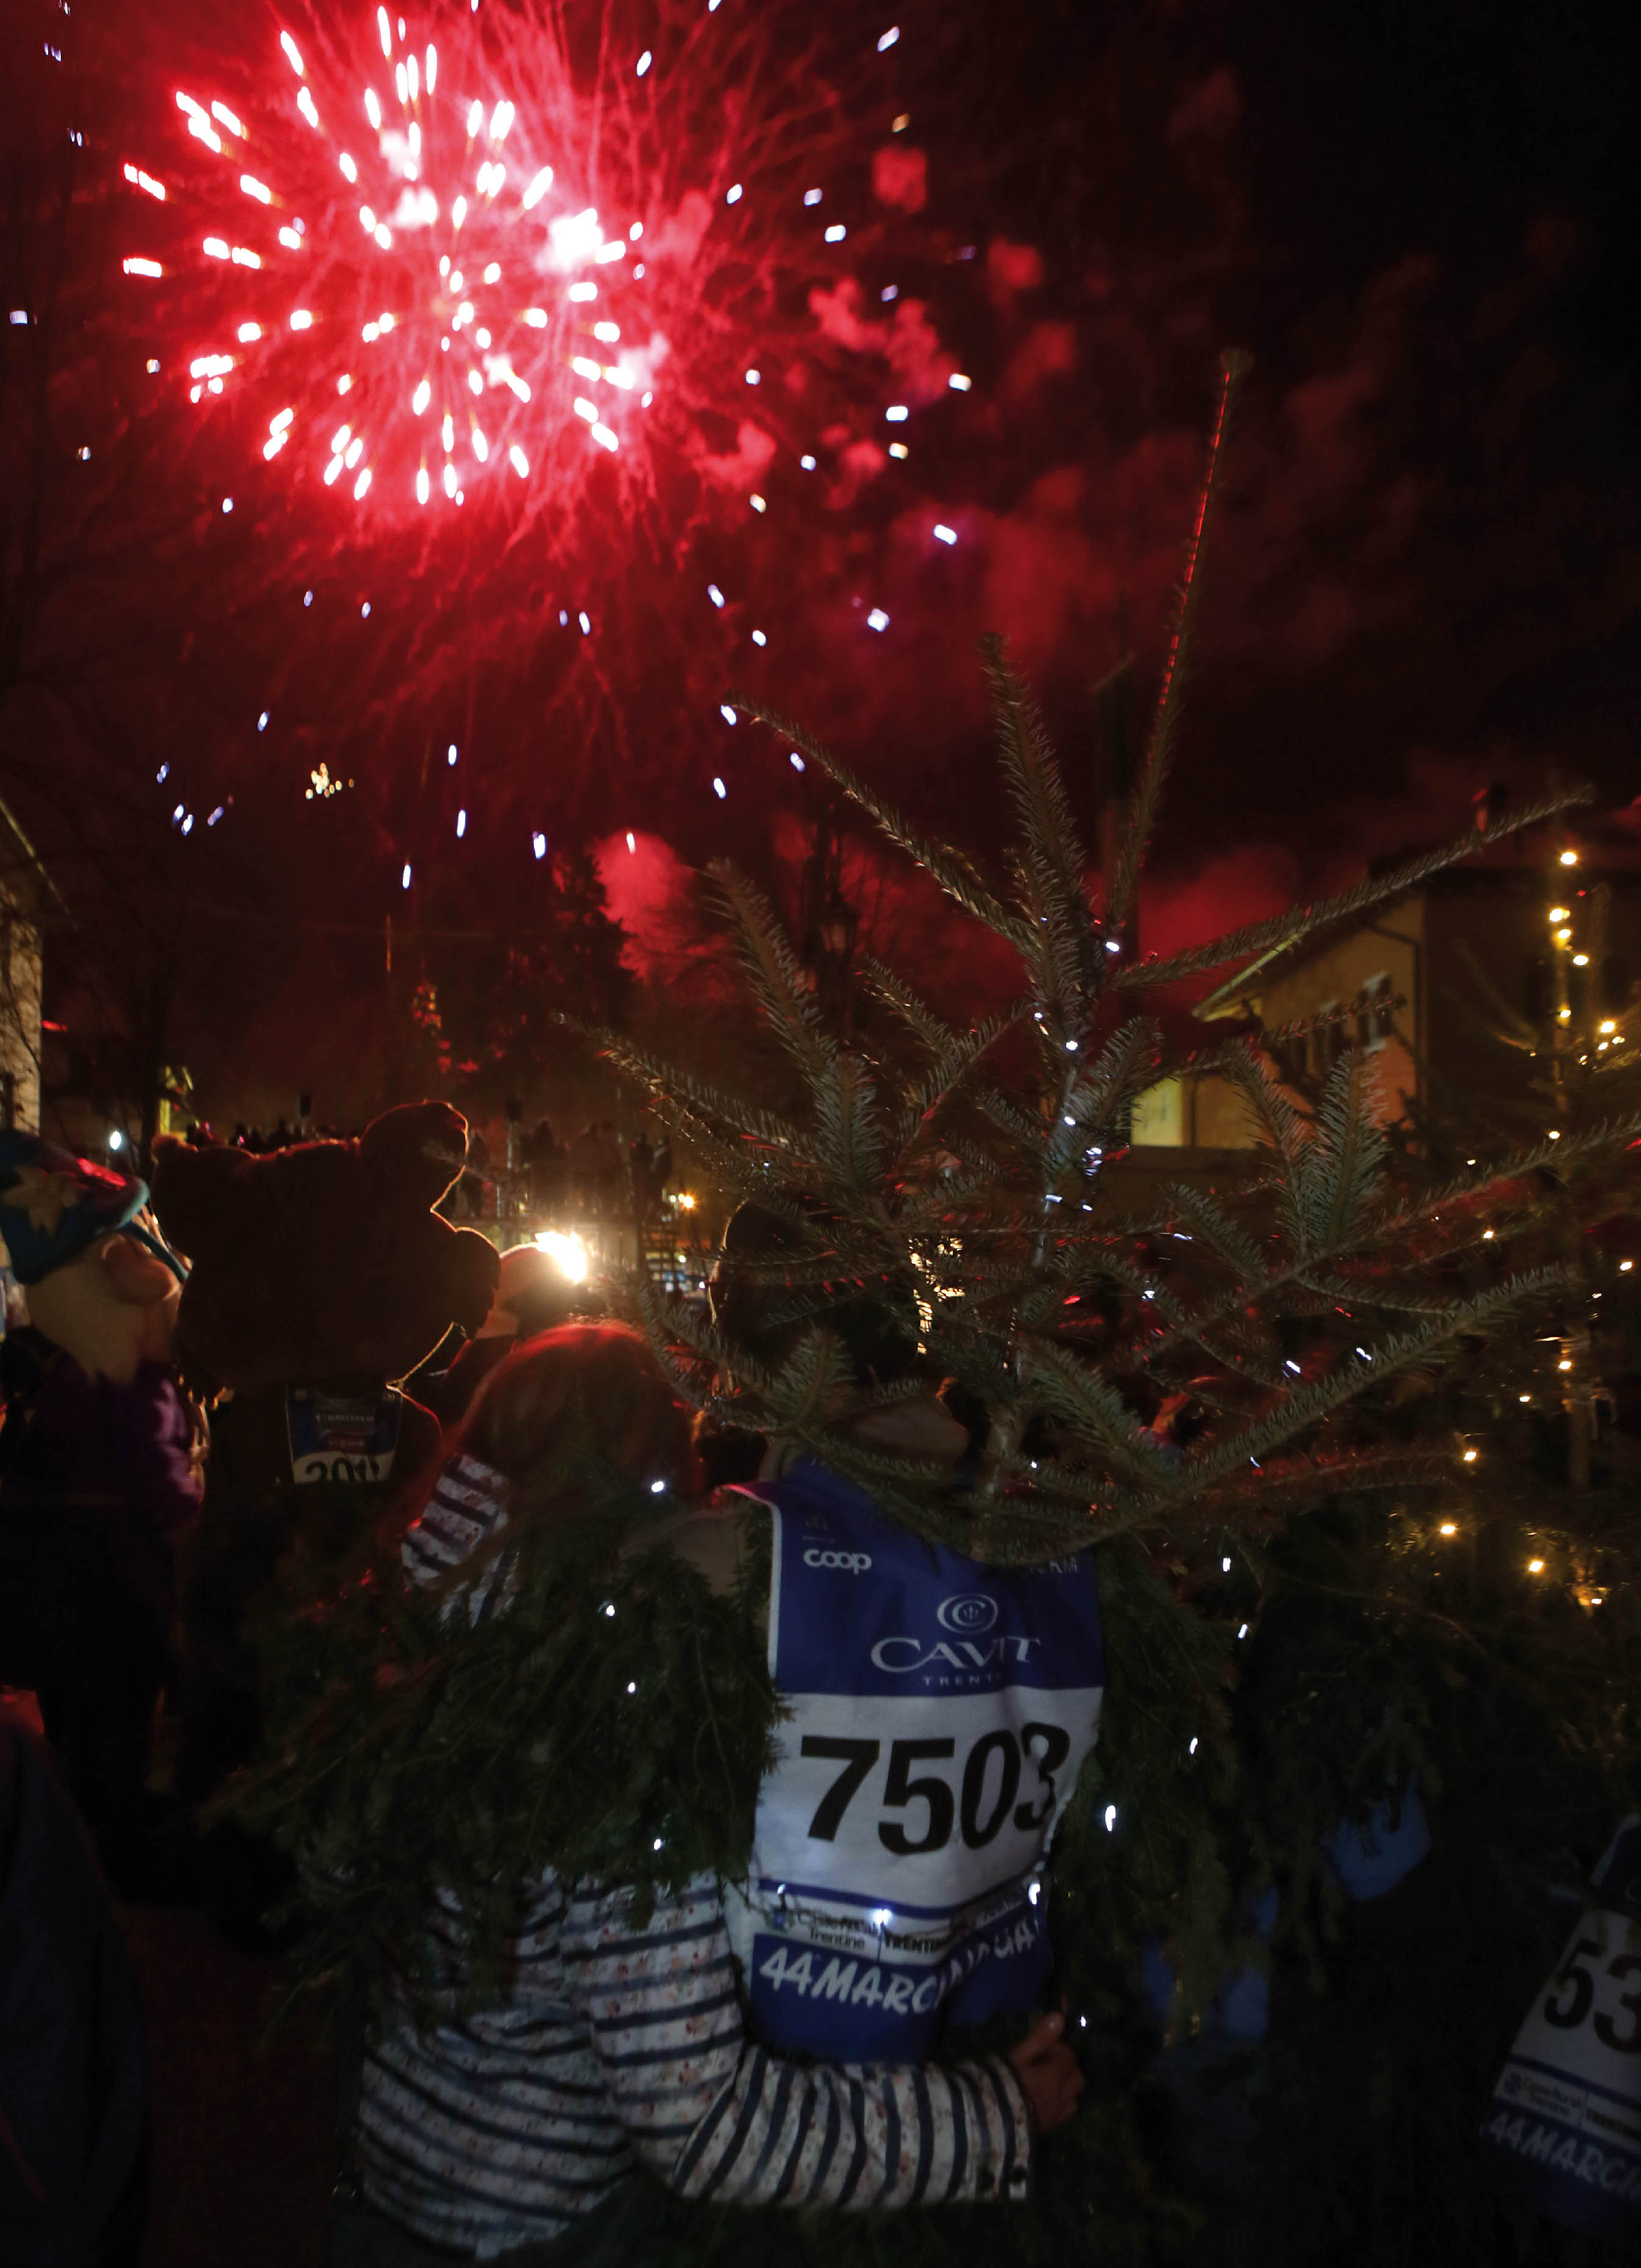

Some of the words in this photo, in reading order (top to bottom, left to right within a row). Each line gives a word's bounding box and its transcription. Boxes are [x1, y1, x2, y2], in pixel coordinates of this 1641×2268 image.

[802, 1549, 872, 1575] coop
[870, 1635, 1042, 1673] CAVIT
[801, 1722, 1070, 1855] 7503
